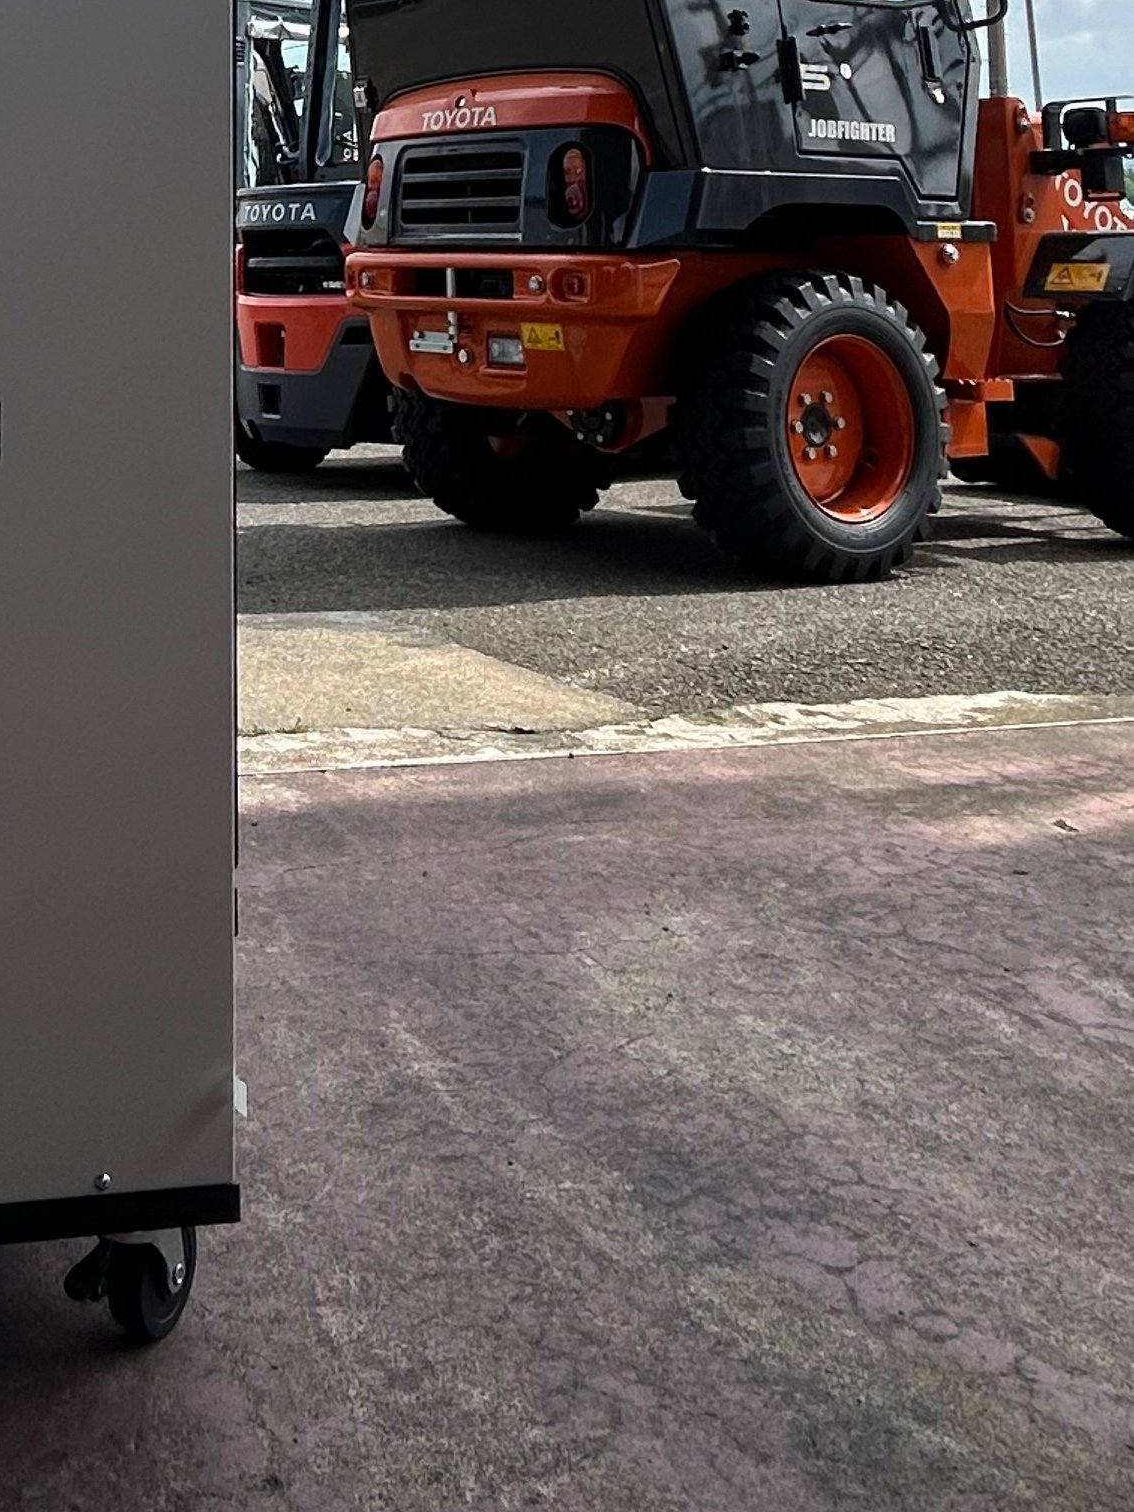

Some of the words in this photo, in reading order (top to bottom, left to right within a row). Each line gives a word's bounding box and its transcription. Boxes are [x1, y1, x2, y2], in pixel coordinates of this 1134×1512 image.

[422, 106, 497, 131] TOYOTA
[808, 118, 896, 143] JOBFIGHTER
[245, 202, 317, 222] TOYOTA
